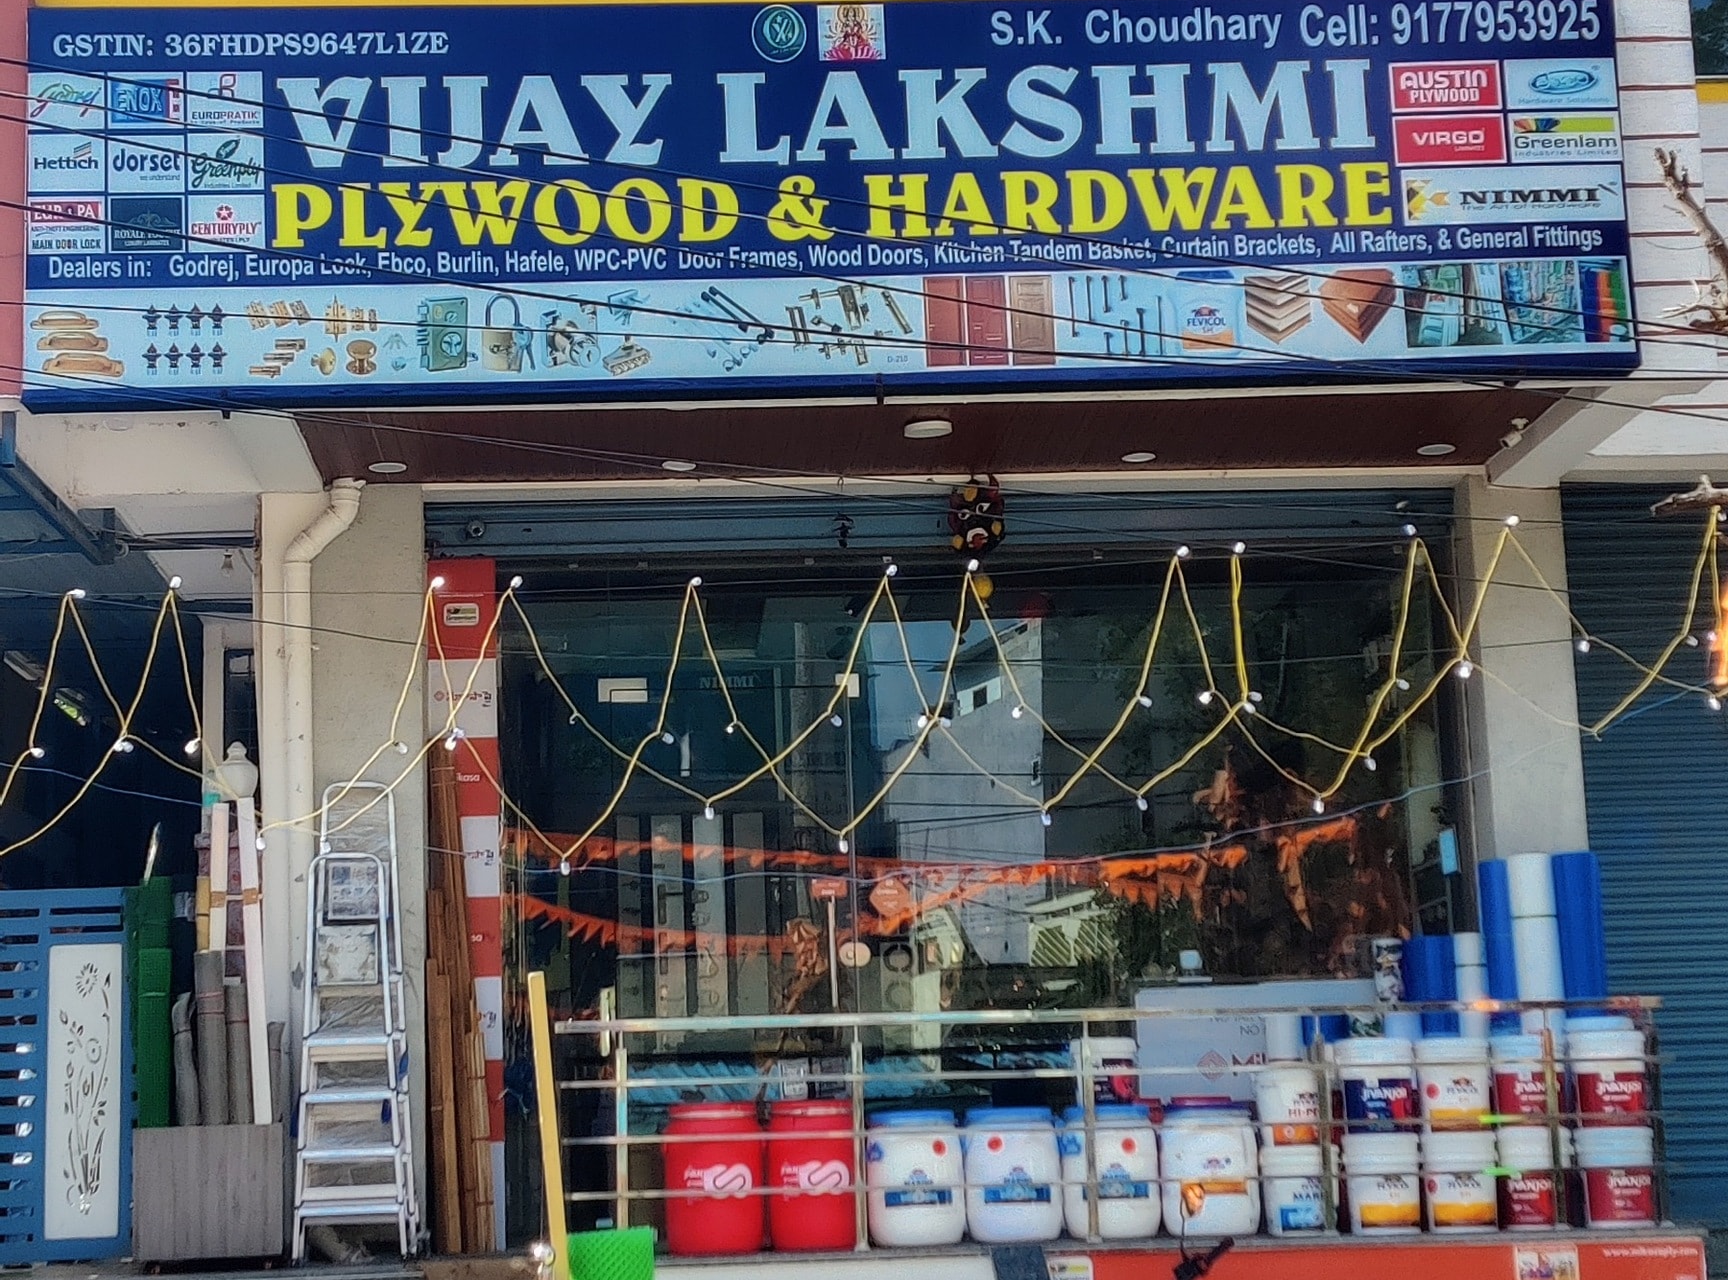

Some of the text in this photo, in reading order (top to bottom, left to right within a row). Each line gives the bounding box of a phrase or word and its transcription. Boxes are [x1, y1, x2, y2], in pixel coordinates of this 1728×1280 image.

[990, 0, 1600, 48] S.K. Choudhary Cell: 9177953925
[54, 31, 449, 57] GSTIN: 36FHDPS9647L1ZE
[1400, 69, 1488, 89] AUSTIN
[1409, 88, 1480, 103] PLYWOOD
[191, 110, 259, 120] EUROPRATIK
[276, 59, 1376, 168] VIJAY LAKSHMI
[1411, 130, 1485, 146] VIRGO
[1514, 134, 1618, 149] Greenlam
[34, 155, 99, 170] Hettich
[112, 148, 181, 172] dorset
[272, 161, 1393, 248] PLYWOOD & HARDWARE
[1459, 187, 1600, 205] NIMMI
[56, 238, 78, 249] DOOR
[80, 238, 102, 249] LOCK
[48, 225, 1604, 283] Dealers in: Godrej, Europa Lock, Ebco, Burlin, Hafele, WPC-PVC Door Frames, Wood Doors, Kitchen Tandem Basket, Curtain Brackets, All Rafters, & General Fittings
[1186, 316, 1227, 327] FEVICOL
